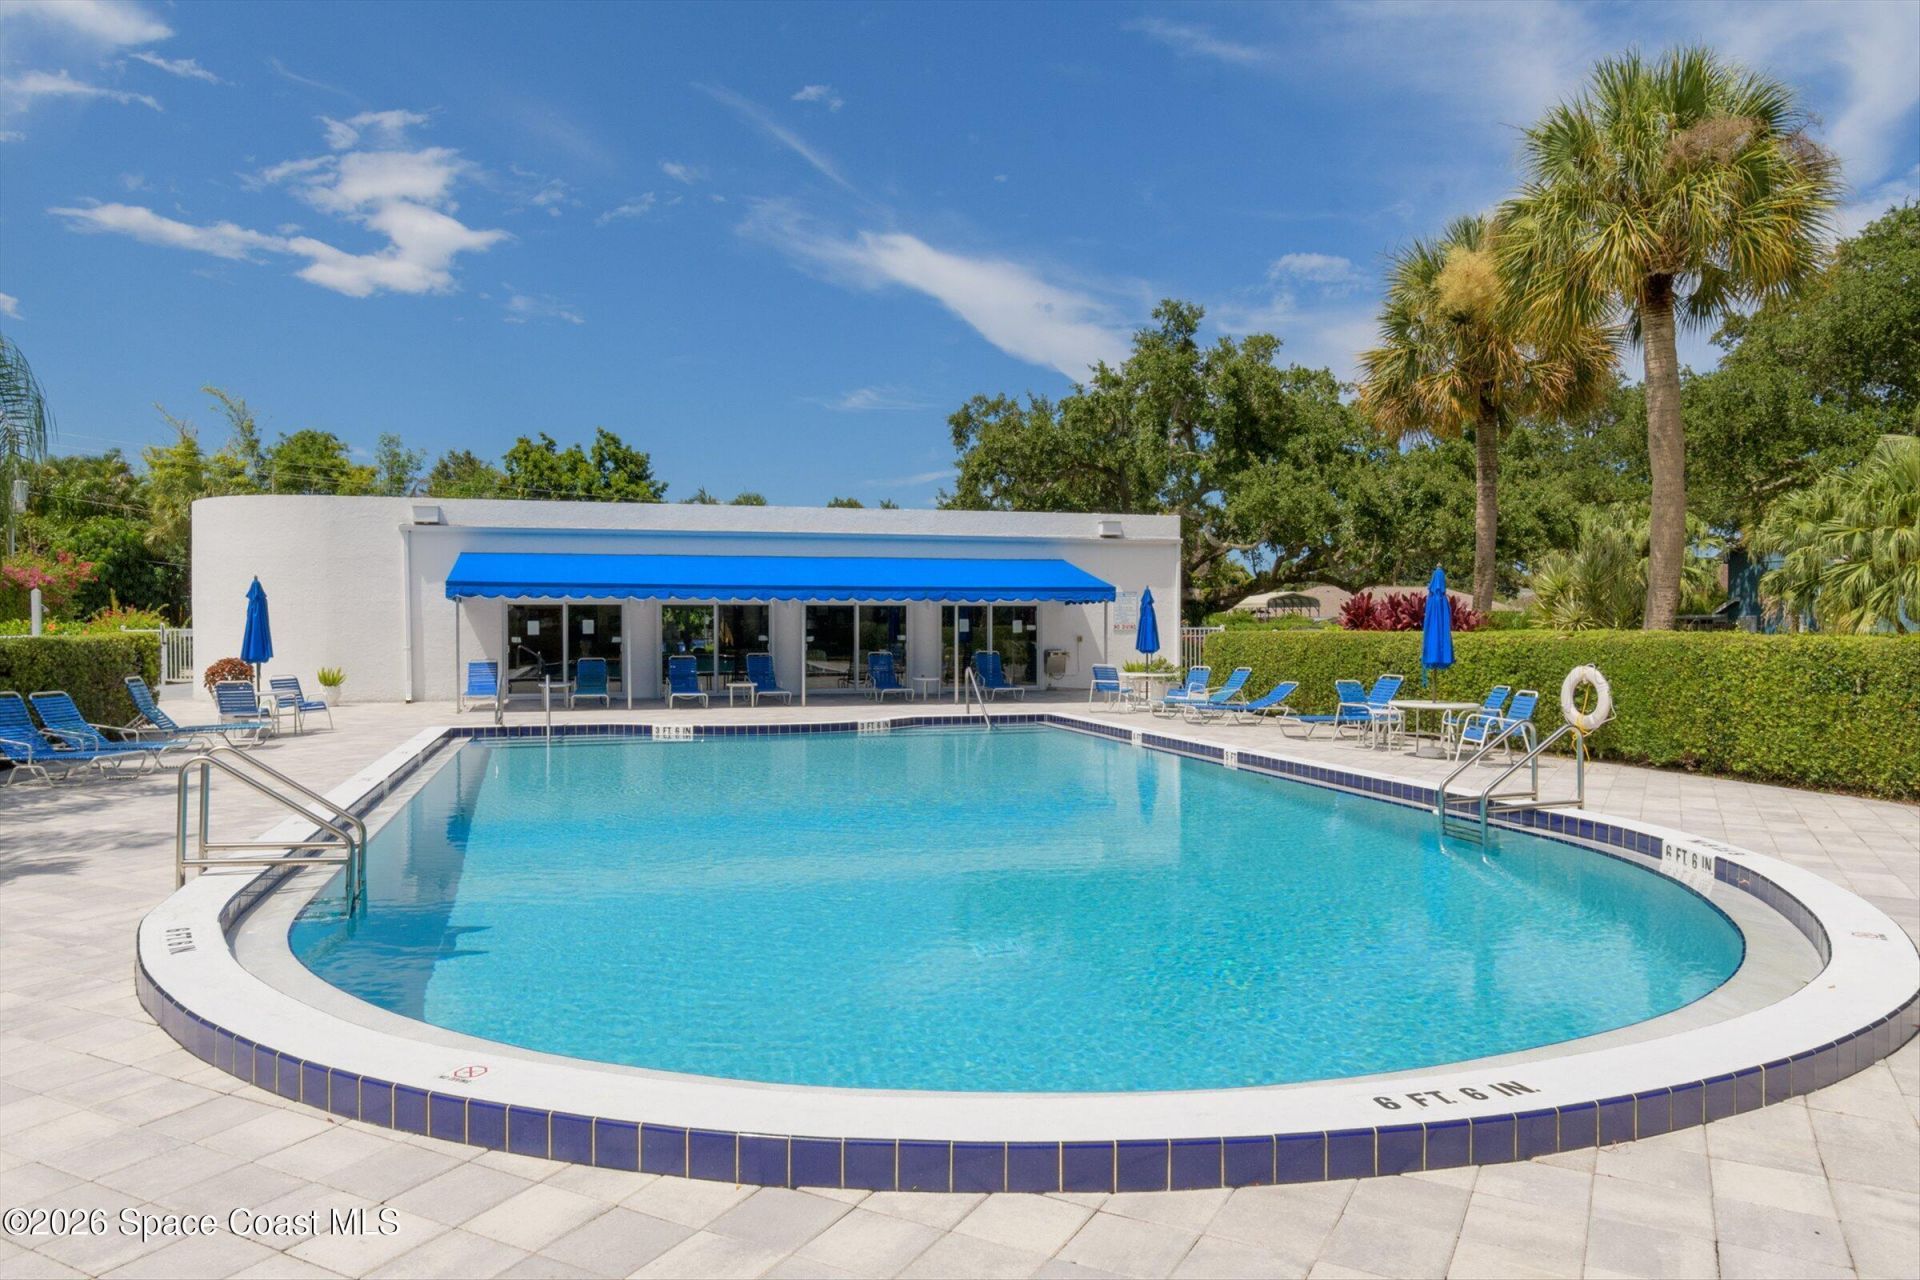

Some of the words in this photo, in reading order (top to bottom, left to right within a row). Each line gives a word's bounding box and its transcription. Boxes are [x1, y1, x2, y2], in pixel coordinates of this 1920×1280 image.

[1691, 852, 1698, 869] 6
[1373, 1096, 1402, 1110] 6
[1405, 1090, 1458, 1108] FT.
[1458, 1087, 1489, 1100] 6
[1488, 1080, 1542, 1097] IN.
